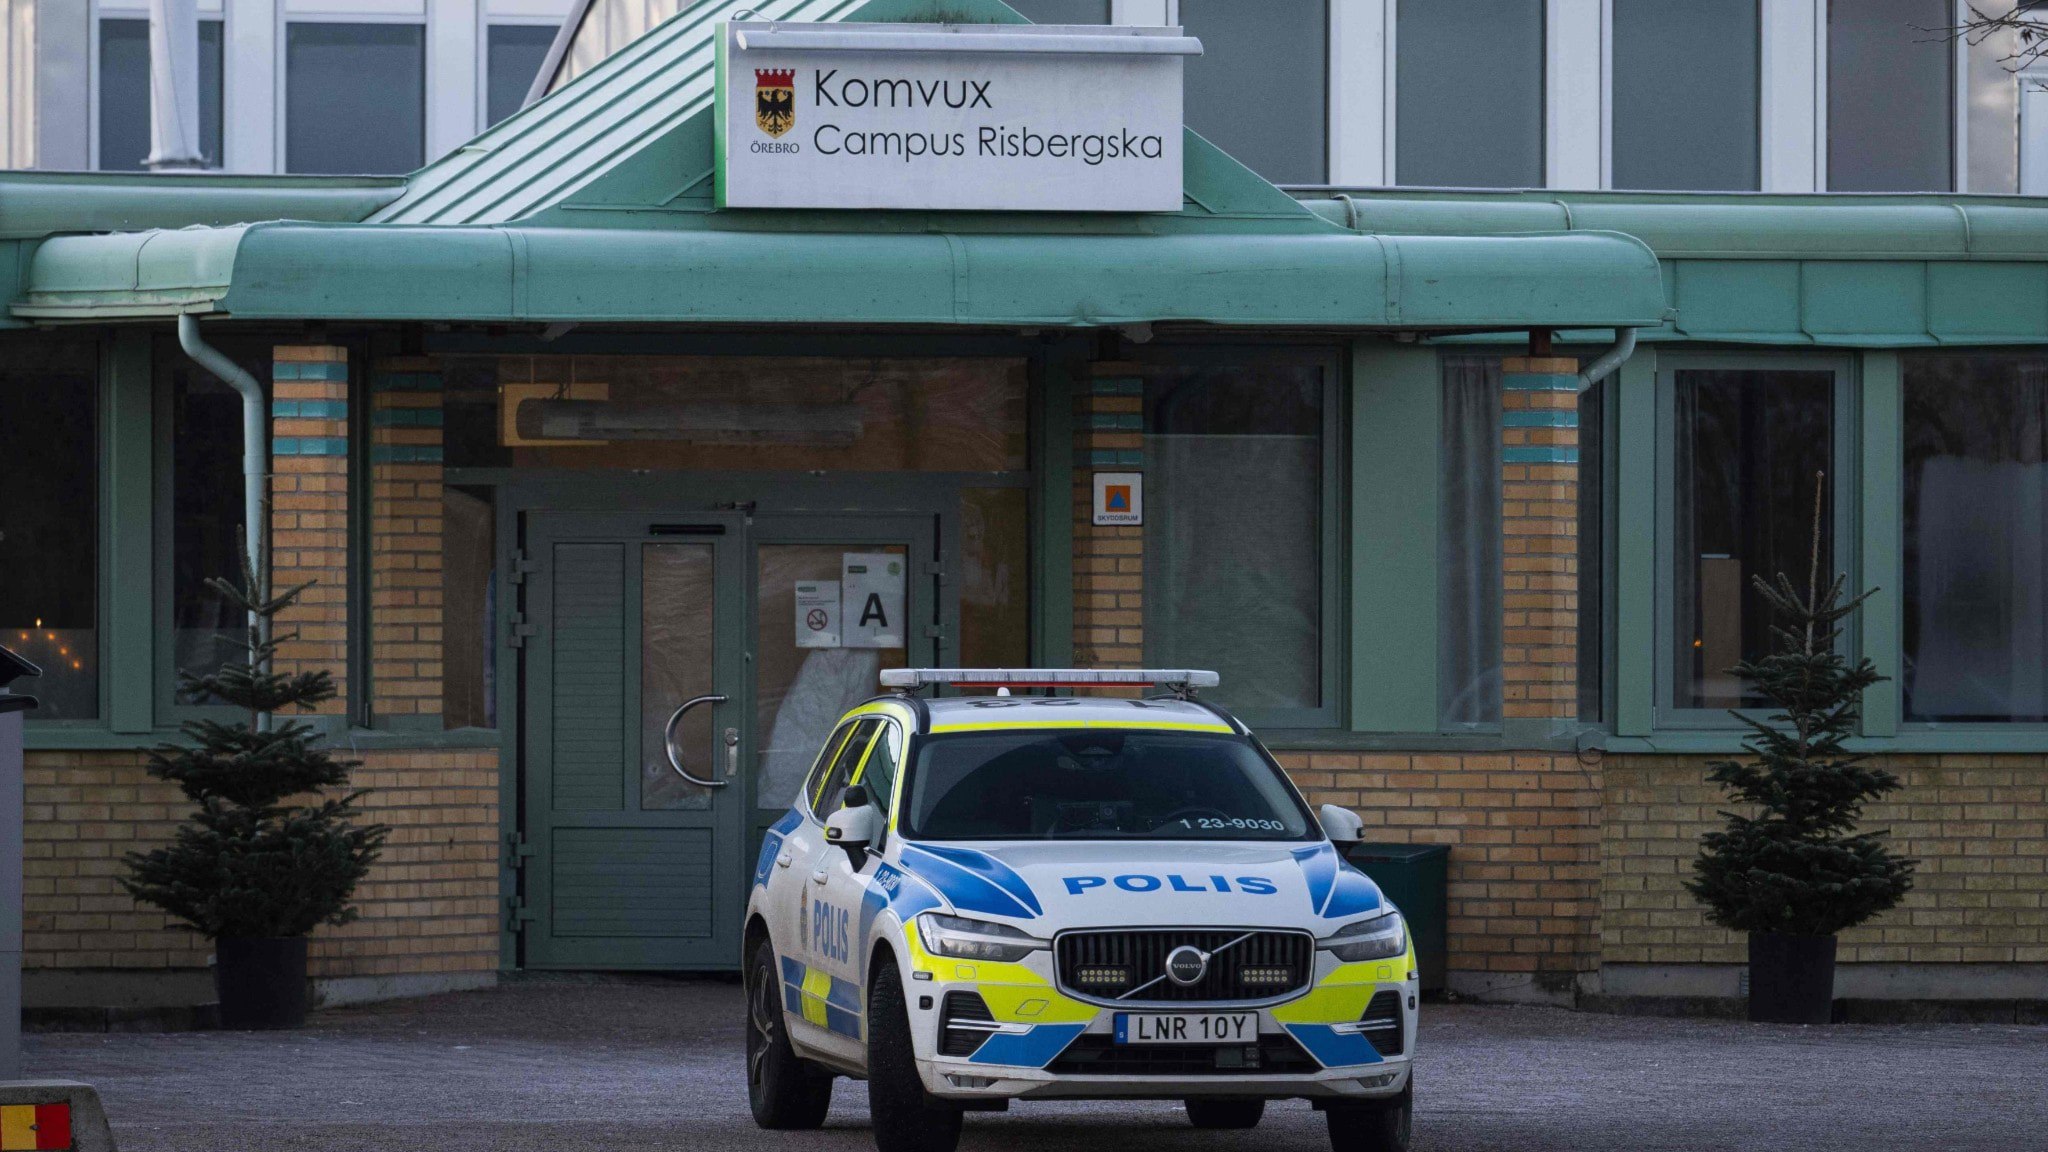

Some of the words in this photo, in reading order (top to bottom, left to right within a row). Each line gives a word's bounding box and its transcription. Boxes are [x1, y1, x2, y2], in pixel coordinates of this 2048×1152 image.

[815, 69, 992, 109] Komvux
[750, 139, 800, 154] ÖREBRO
[814, 124, 965, 162] Campus
[978, 126, 1163, 165] Risbergska
[859, 593, 888, 627] A
[1180, 818, 1192, 830] 1
[1200, 818, 1285, 831] 23-9030
[1062, 874, 1278, 895] POLIS
[814, 899, 849, 964] POLIS
[1138, 1016, 1187, 1040] LNR
[1199, 1015, 1247, 1039] 10Y
